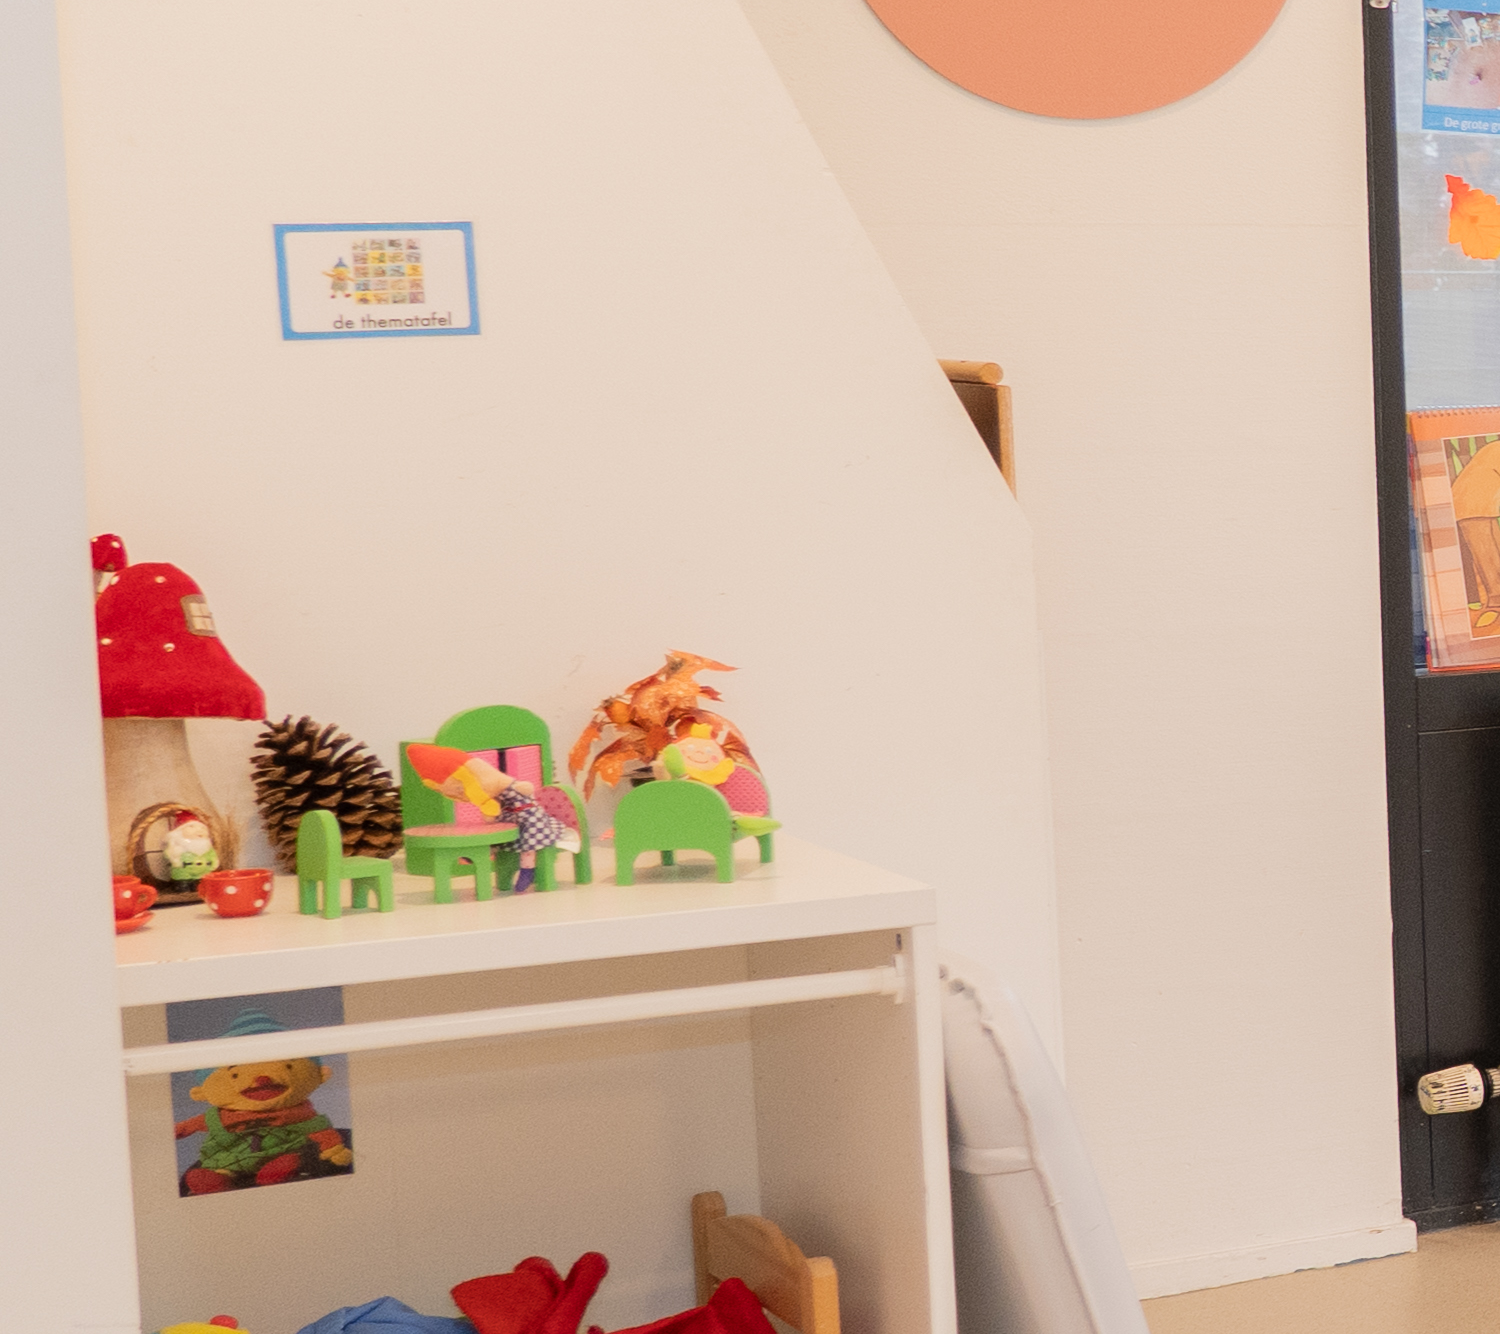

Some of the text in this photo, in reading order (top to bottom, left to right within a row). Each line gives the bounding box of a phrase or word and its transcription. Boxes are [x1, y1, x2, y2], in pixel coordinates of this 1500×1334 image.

[1444, 117, 1460, 129] De
[1461, 118, 1489, 132] grote
[333, 311, 452, 330] de thematafel
